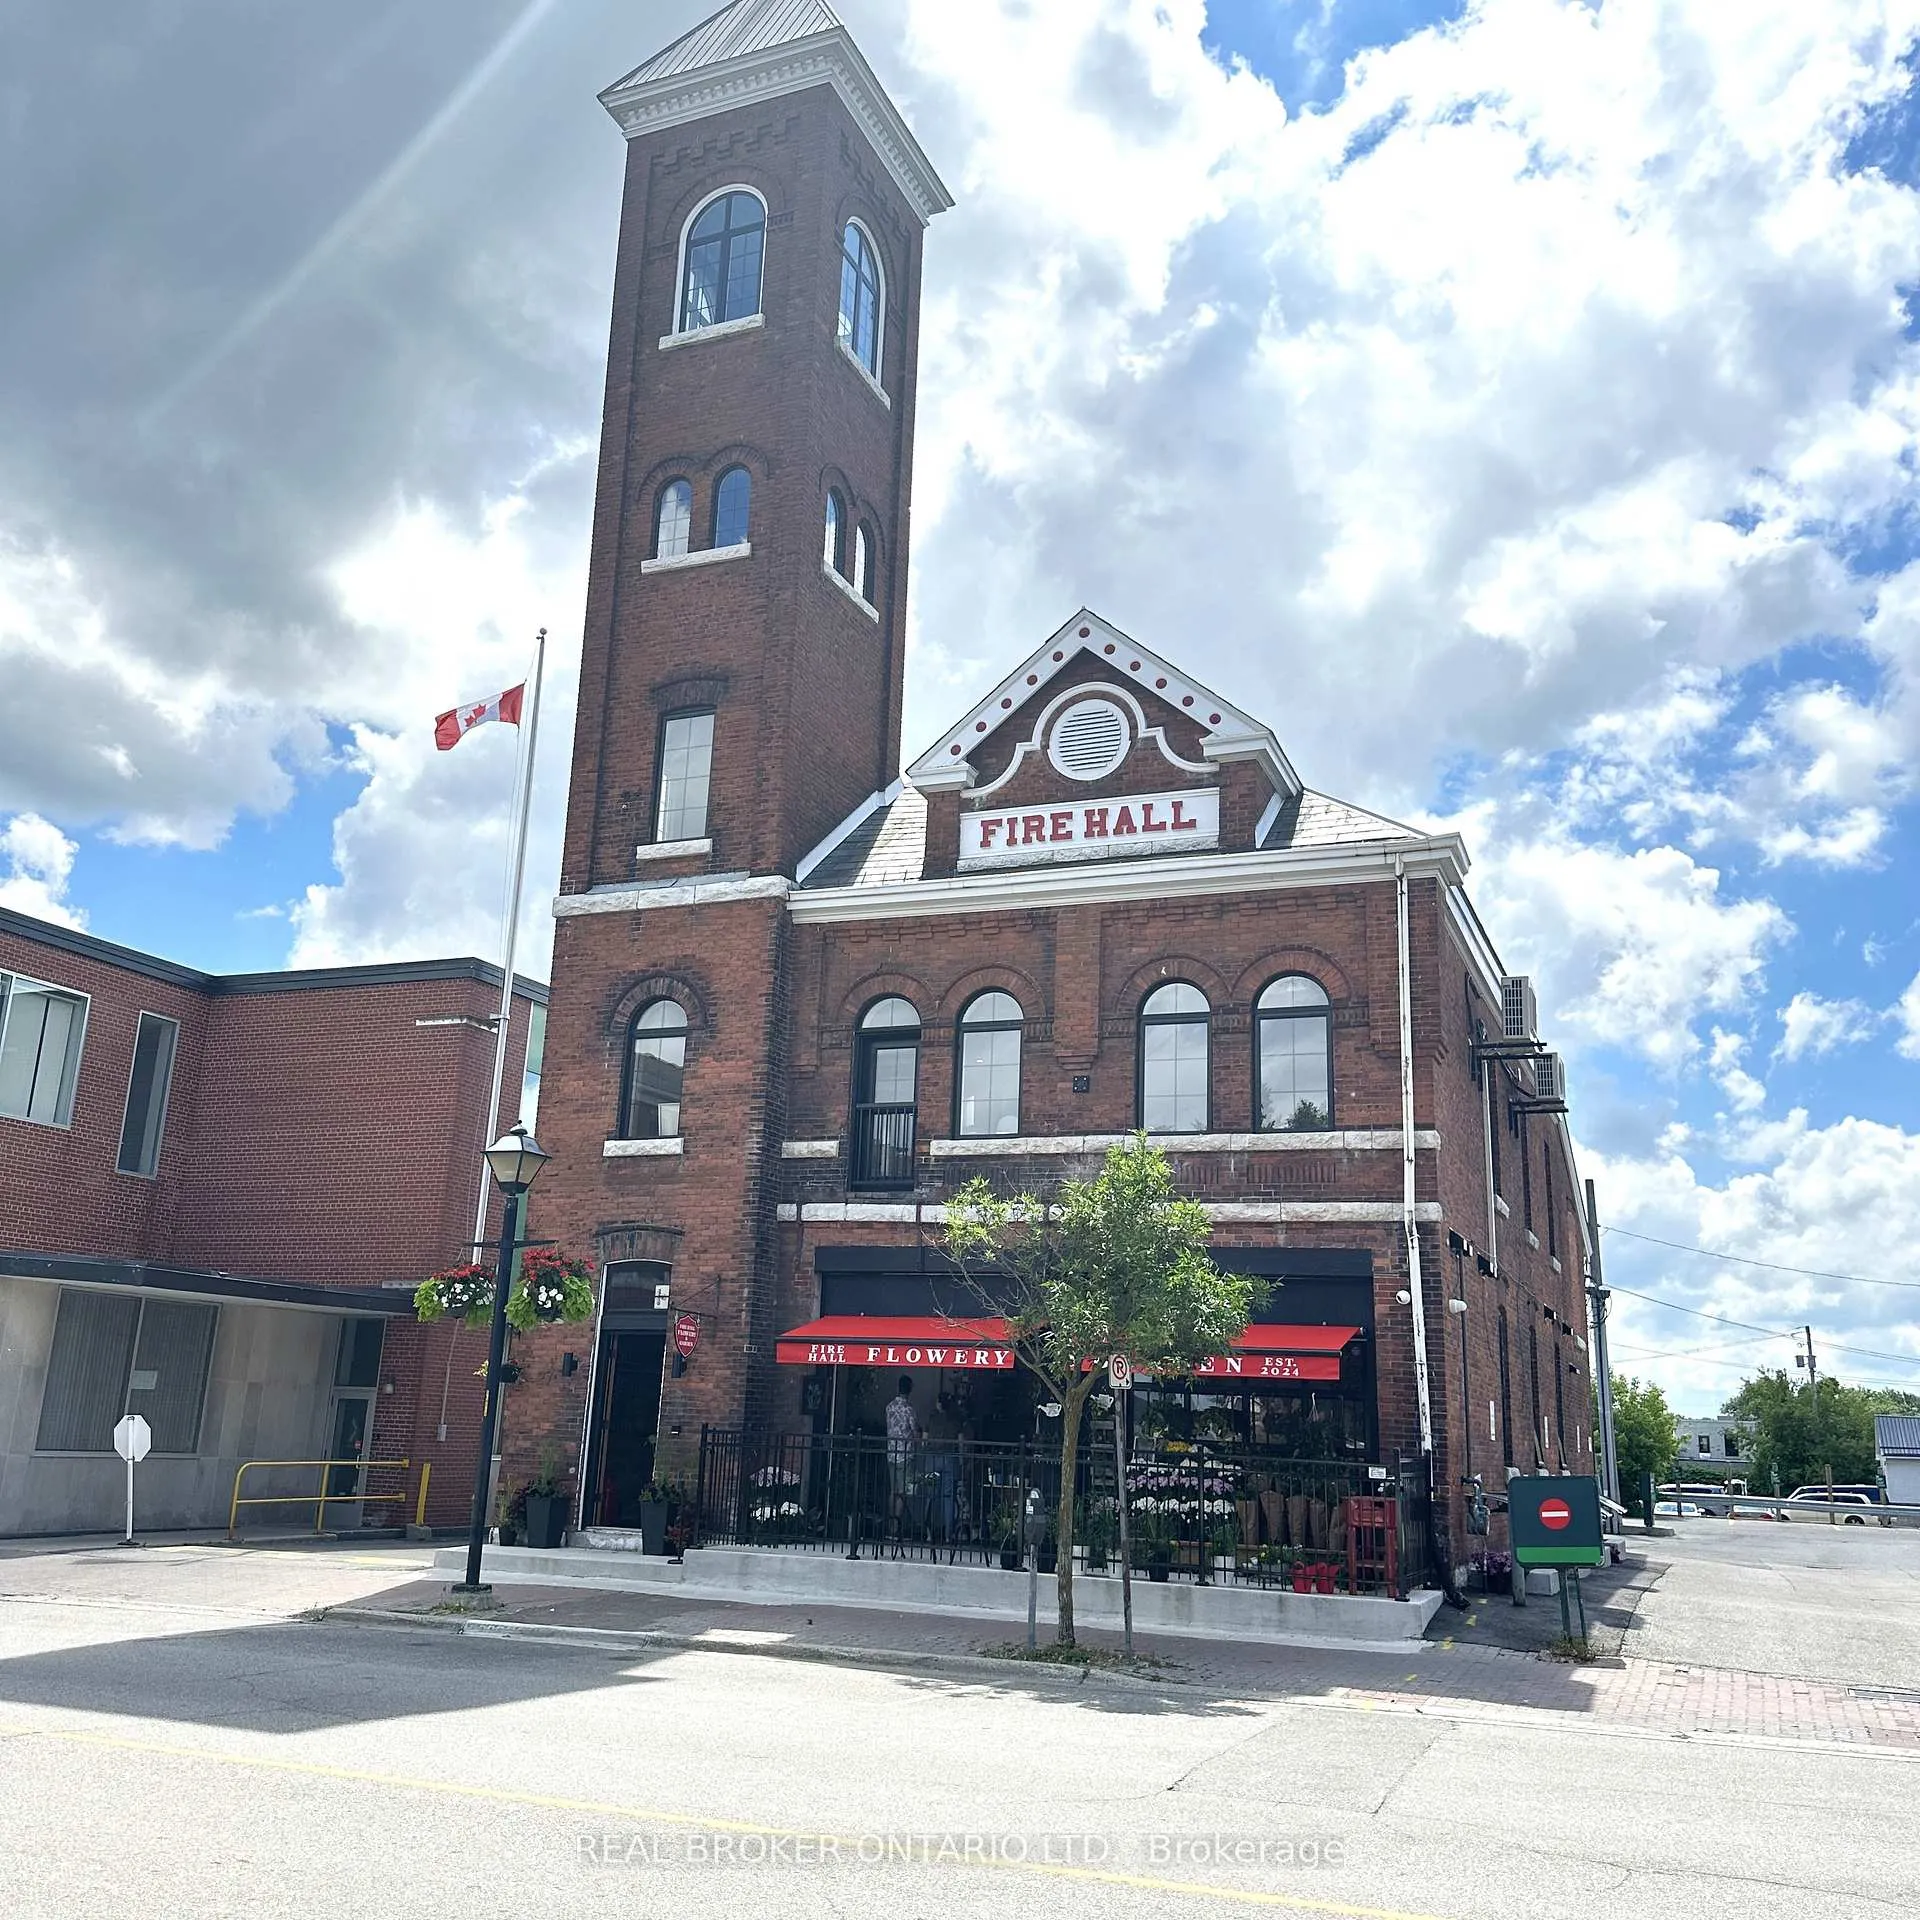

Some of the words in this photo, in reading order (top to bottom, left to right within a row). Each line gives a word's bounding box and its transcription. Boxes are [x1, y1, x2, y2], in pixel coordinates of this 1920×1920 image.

[980, 812, 1073, 848] FIRE
[1084, 801, 1197, 838] HALL
[811, 1344, 845, 1354] FIRE
[808, 1353, 846, 1363] HALL
[867, 1347, 1009, 1366] FLOWERY
[1264, 1357, 1297, 1367] EST.
[1260, 1367, 1299, 1377] 2024
